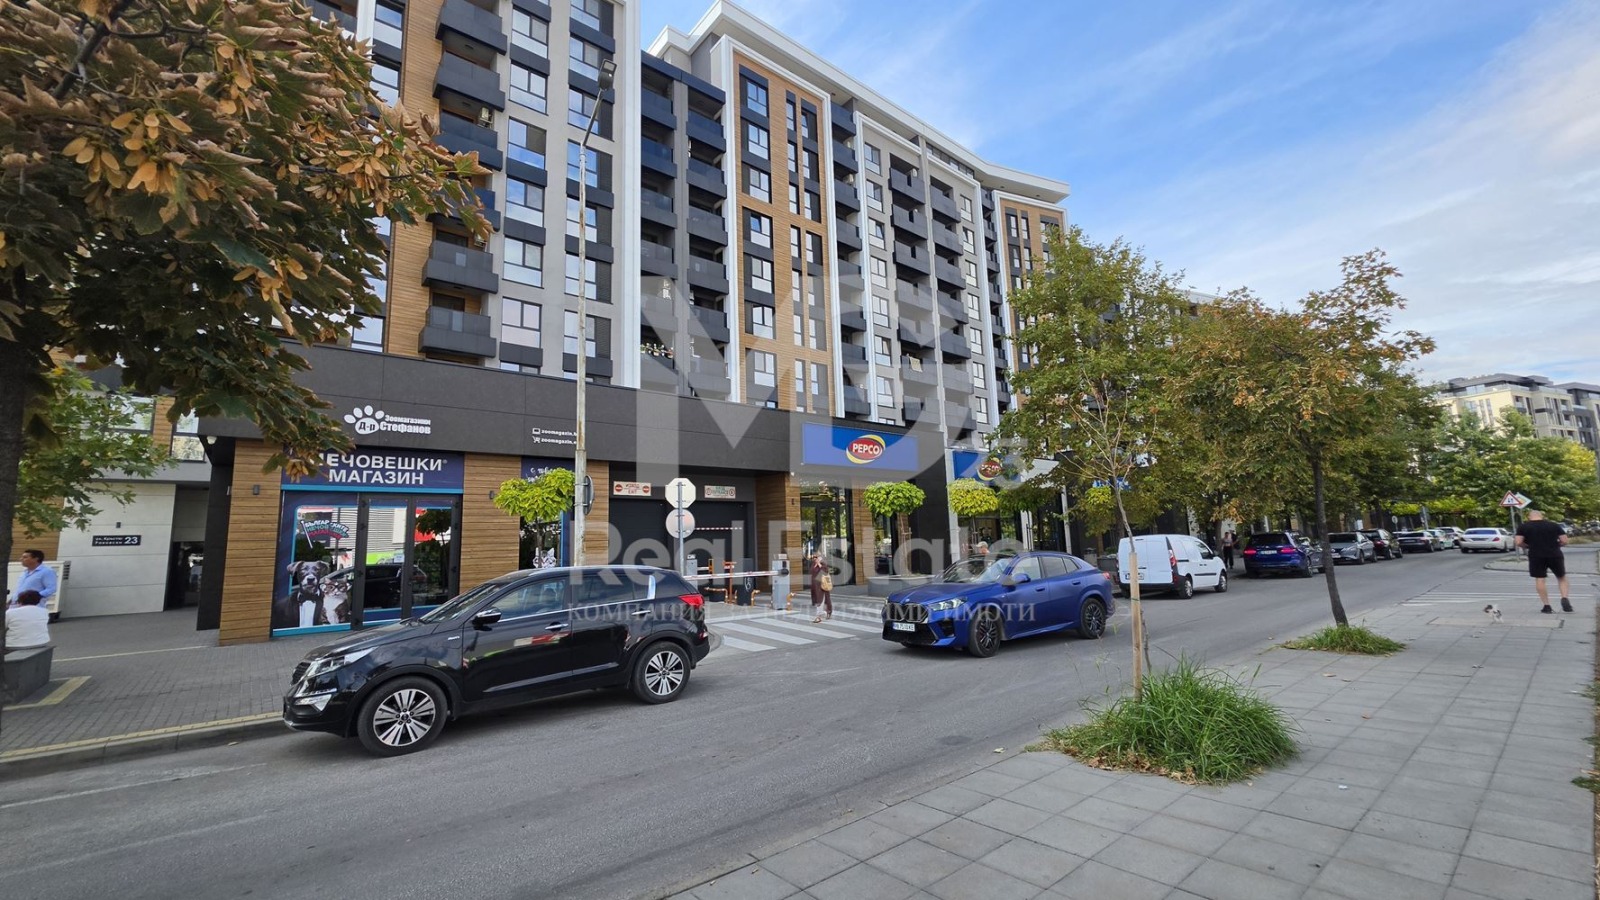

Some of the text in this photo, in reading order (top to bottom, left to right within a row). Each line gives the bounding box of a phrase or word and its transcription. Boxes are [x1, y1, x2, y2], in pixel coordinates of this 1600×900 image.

[379, 421, 431, 434] Стефанов
[541, 429, 577, 437] zoomagazin.b
[852, 443, 881, 456] PEPCO
[328, 469, 424, 485] МАГАЗИН
[123, 537, 138, 545] 23
